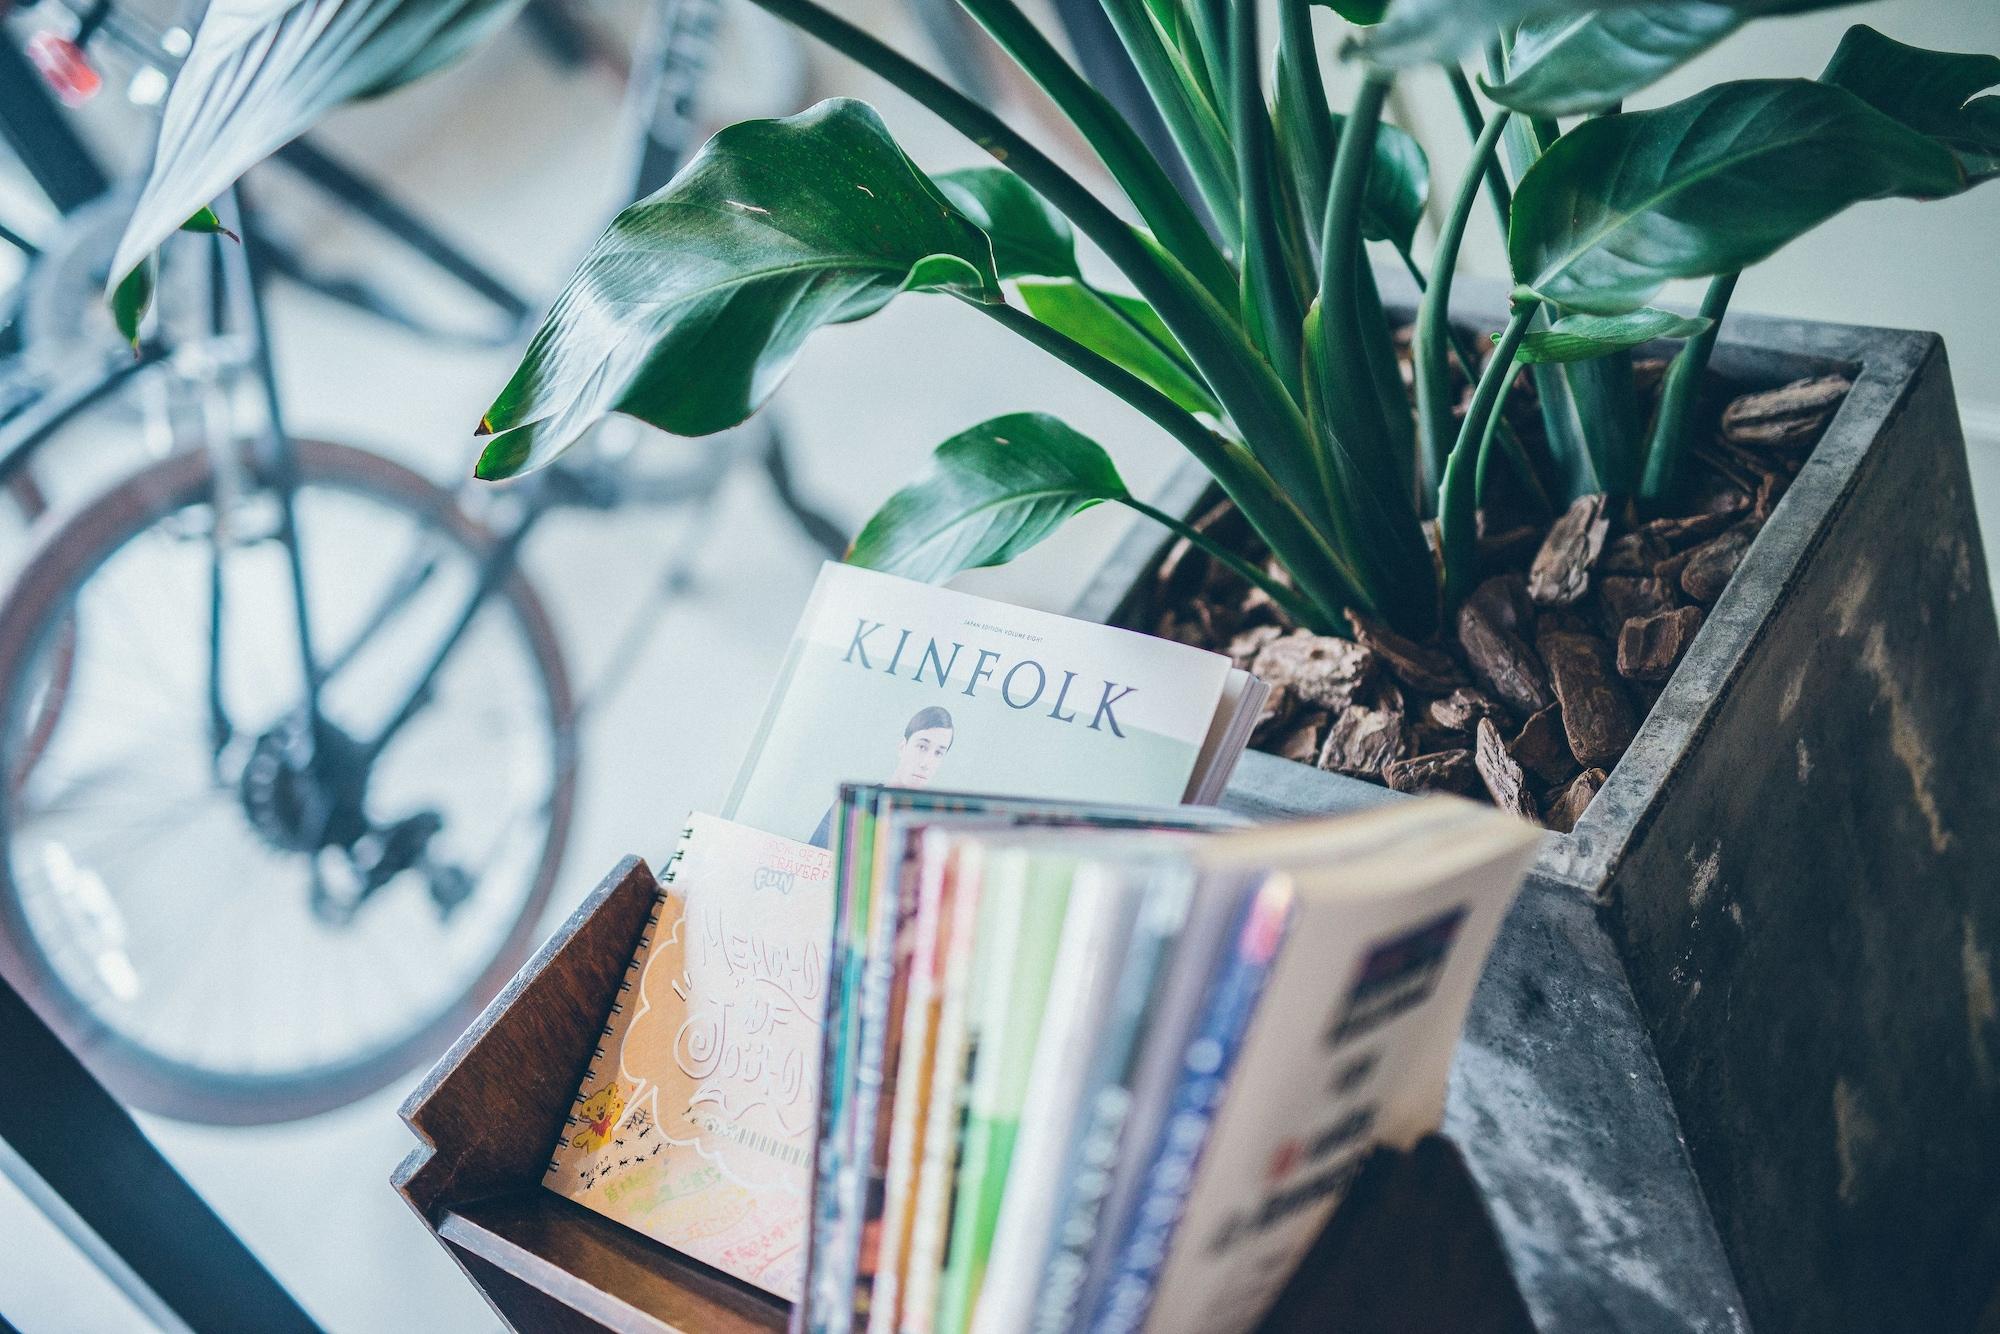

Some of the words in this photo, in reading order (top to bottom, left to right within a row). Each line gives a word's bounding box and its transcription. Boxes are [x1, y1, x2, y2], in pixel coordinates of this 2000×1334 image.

[963, 619, 981, 628] JAPAN
[981, 624, 1003, 634] EDITION
[1004, 630, 1026, 639] VOLUME
[1027, 634, 1044, 643] EIGHT
[841, 618, 1139, 739] KINFOLK
[754, 866, 795, 895] FUN
